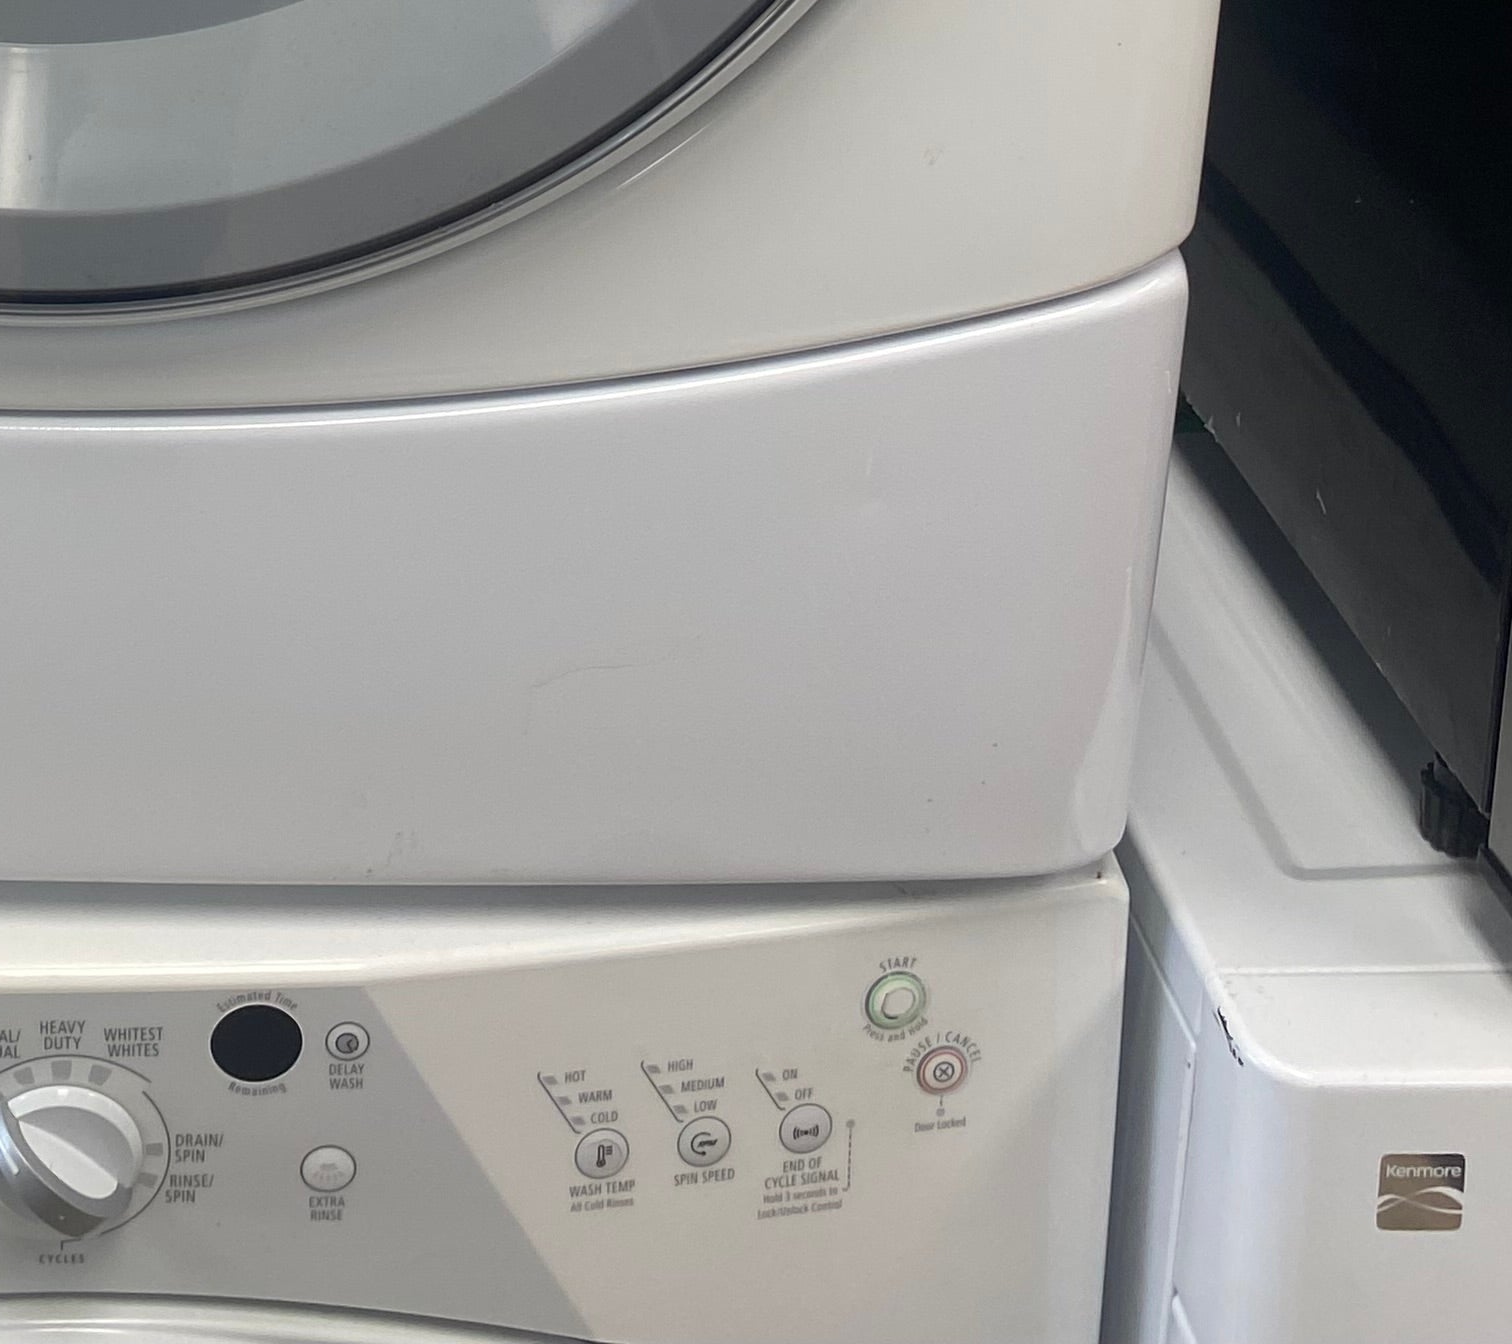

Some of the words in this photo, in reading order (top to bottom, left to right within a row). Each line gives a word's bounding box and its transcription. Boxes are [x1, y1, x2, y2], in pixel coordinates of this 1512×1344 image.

[879, 956, 917, 972] START
[216, 991, 272, 1012] Estimated
[276, 992, 298, 1010] Time
[40, 1020, 85, 1035] HEAVY
[104, 1027, 163, 1042] WHITEST
[862, 1024, 884, 1042] Press
[888, 1030, 906, 1042] and
[44, 1036, 82, 1051] DUTY
[108, 1043, 159, 1057] WHITES
[903, 1035, 934, 1072] PAUSE
[945, 1031, 982, 1063] CANCEL
[329, 1064, 364, 1077] DELAY
[668, 1059, 693, 1072] HIGH
[564, 1070, 586, 1083] HOT
[782, 1069, 797, 1080] ON
[228, 1082, 286, 1096] Remaining
[329, 1078, 363, 1090] WASH
[681, 1077, 725, 1093] MEDIUM
[578, 1090, 612, 1104] WARM
[795, 1088, 813, 1100] OFF
[694, 1099, 718, 1113] LOW
[590, 1111, 618, 1124] COLD
[915, 1122, 935, 1133] Door
[175, 1134, 224, 1148] DRAIN/
[175, 1149, 205, 1162] SPIN
[783, 1159, 804, 1173] END
[808, 1157, 822, 1170] OF
[1386, 1164, 1462, 1179] Kenmore
[170, 1174, 214, 1188] RINSE/
[674, 1172, 698, 1187] SPIN
[702, 1168, 735, 1184] SPEED
[764, 1176, 797, 1190] CYCLE
[801, 1170, 840, 1185] SIGNAL
[569, 1183, 601, 1198] WASH
[606, 1179, 635, 1194] TEMP
[165, 1189, 195, 1203] SPIN
[309, 1196, 345, 1208] EXTRA
[310, 1209, 343, 1221] RINSE
[39, 1254, 85, 1265] CYCLES
